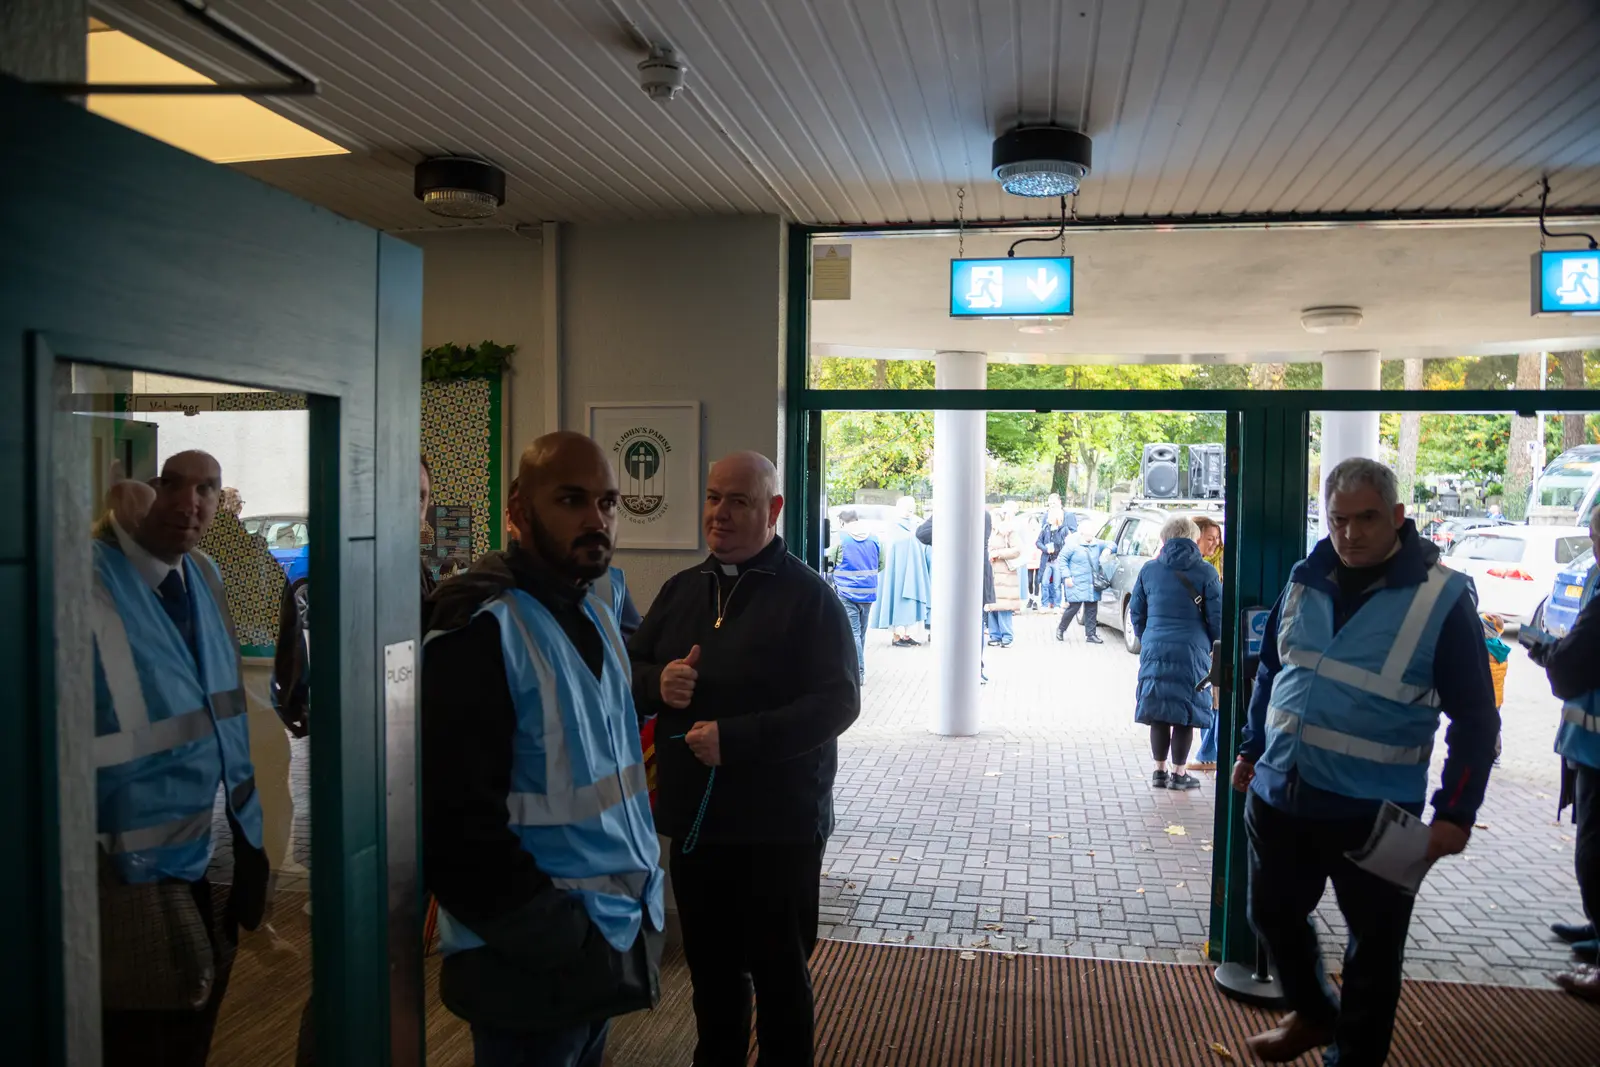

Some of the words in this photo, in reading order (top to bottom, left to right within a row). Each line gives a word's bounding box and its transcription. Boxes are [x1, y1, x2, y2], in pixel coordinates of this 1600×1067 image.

[149, 399, 200, 413] Volnteer
[613, 441, 621, 453] ST
[620, 427, 648, 443] JOHN'S
[648, 428, 672, 453] PARISH
[647, 503, 669, 523] Belfast
[387, 665, 413, 685] PUSH
